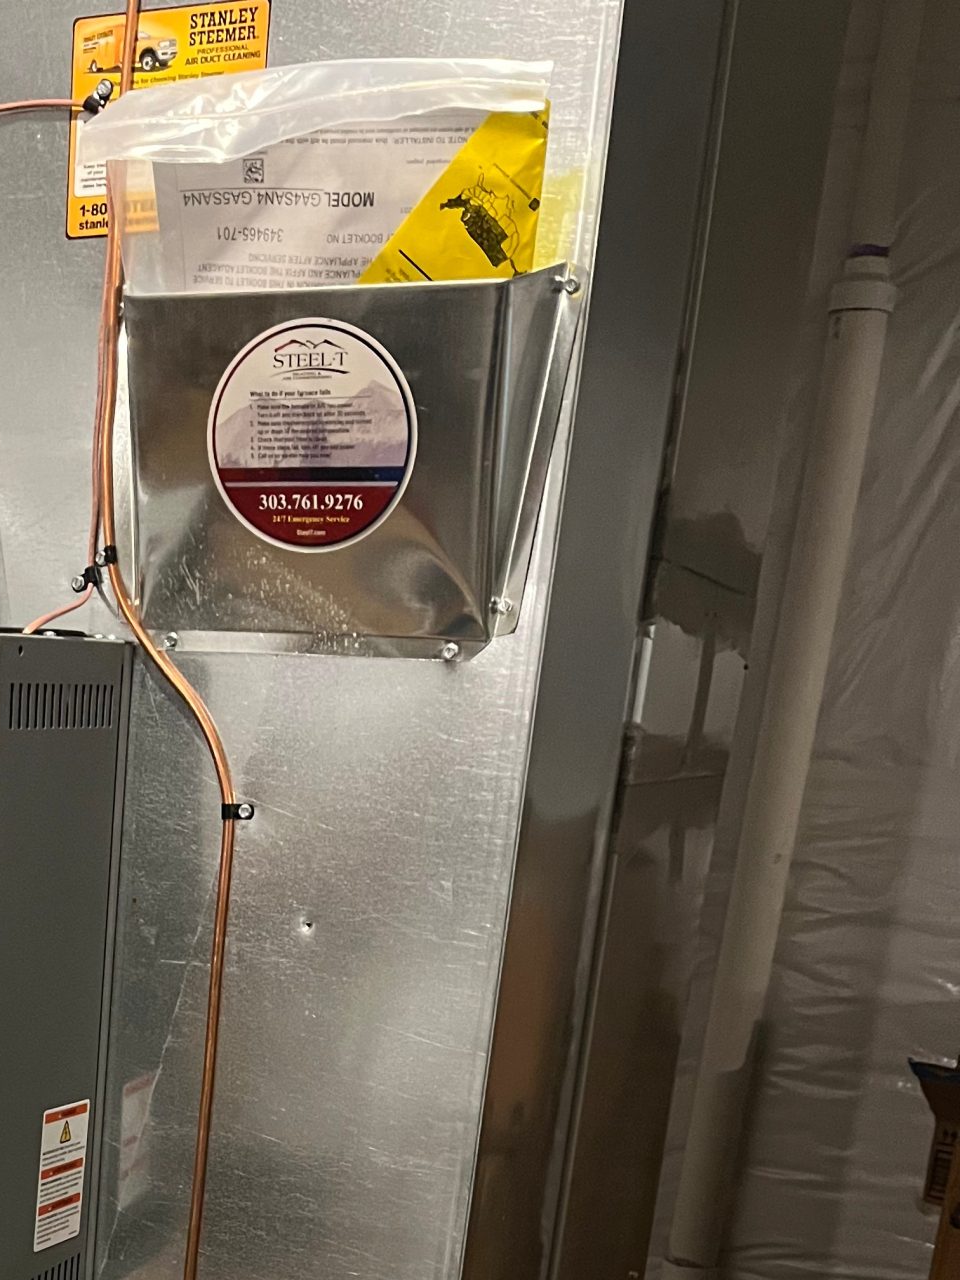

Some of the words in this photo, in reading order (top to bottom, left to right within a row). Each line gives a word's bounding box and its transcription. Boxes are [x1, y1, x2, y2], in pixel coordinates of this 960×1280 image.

[190, 6, 258, 29] STANLEY
[197, 44, 249, 55] PROFESSIONAL
[185, 56, 199, 66] AIR
[201, 54, 221, 65] DUCT
[223, 50, 261, 62] CLEANING
[324, 191, 375, 208] MODEL
[79, 202, 107, 217] 1-80
[216, 227, 284, 243] 349465-701
[327, 233, 339, 244] NO
[342, 233, 383, 245] BOOKLET
[315, 256, 358, 265] APPLIANCE
[325, 269, 361, 278] PLIANCE
[258, 494, 363, 511] 303.761.9276
[326, 515, 351, 523] Service
